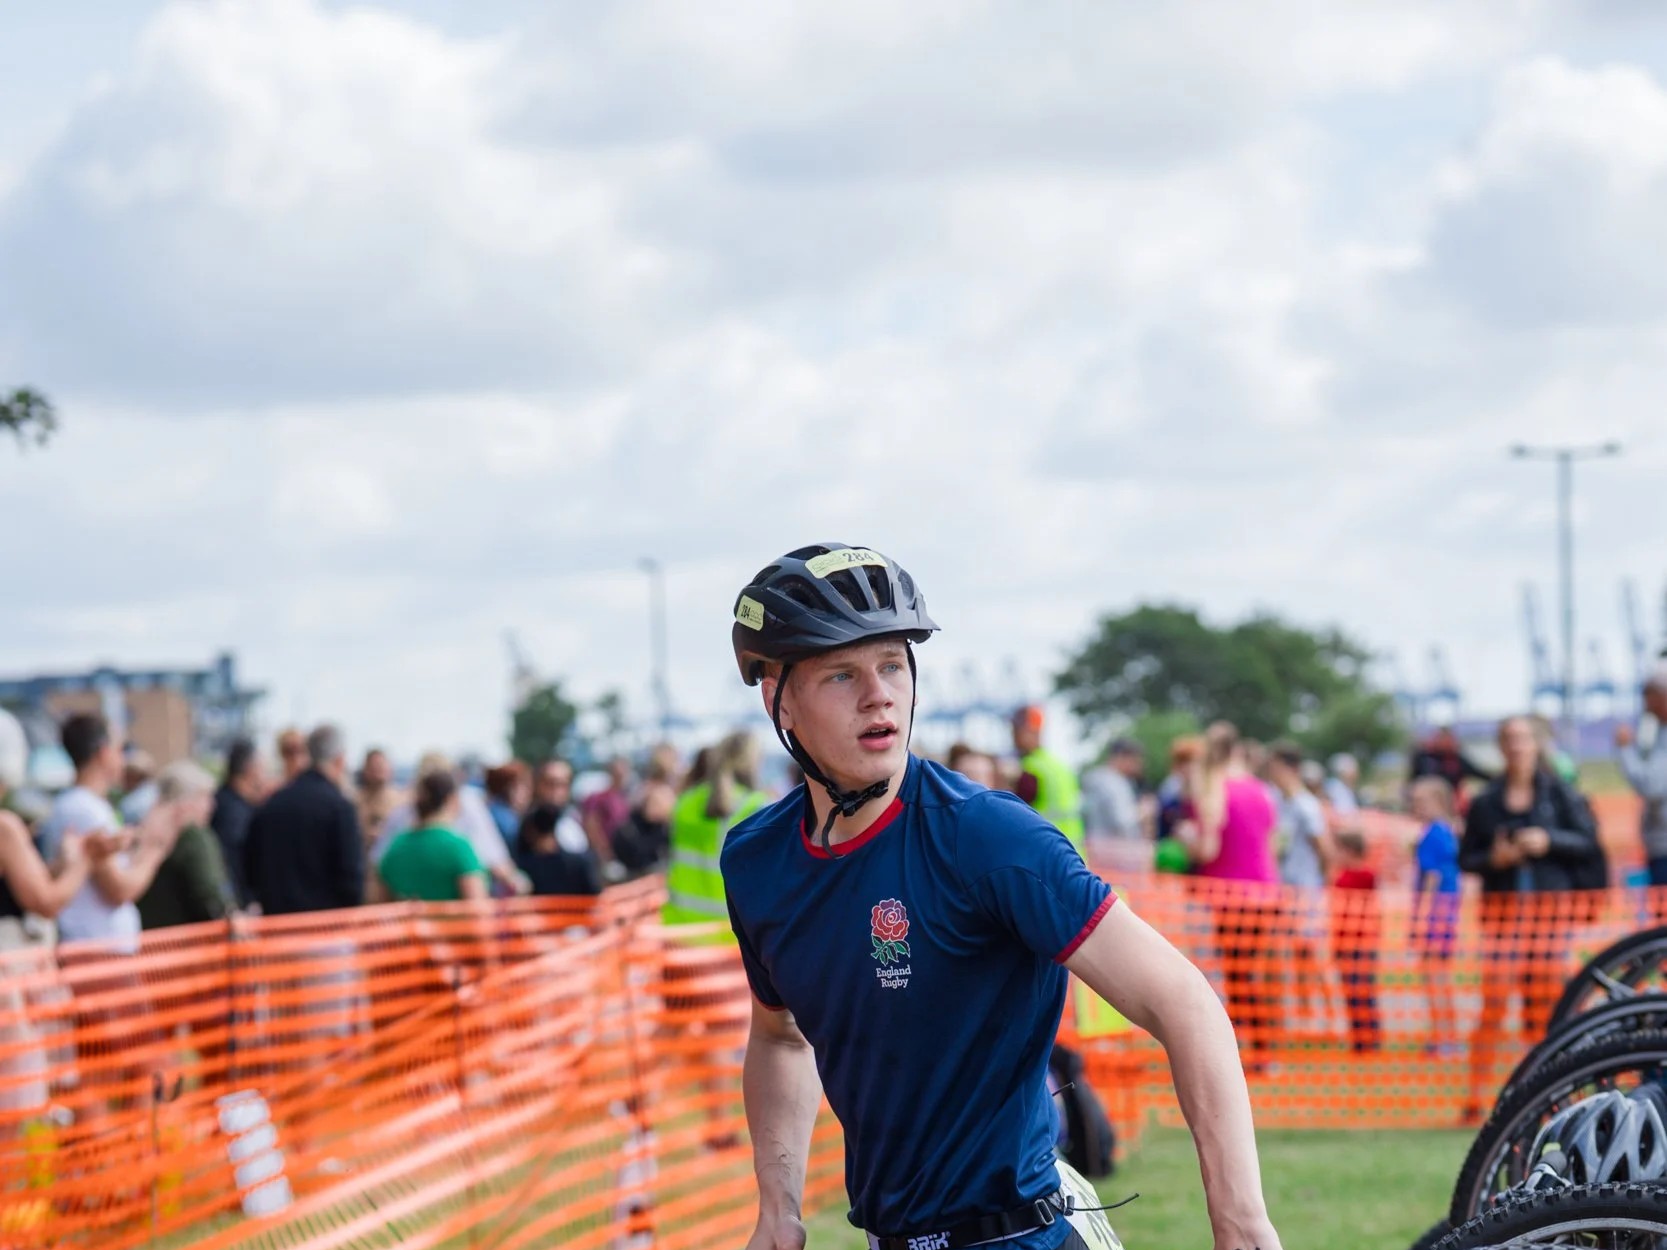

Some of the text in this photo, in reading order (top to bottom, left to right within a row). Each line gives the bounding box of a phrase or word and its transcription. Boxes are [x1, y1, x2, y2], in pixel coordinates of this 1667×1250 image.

[842, 552, 875, 563] 284
[876, 964, 912, 979] England
[881, 977, 909, 989] Rugby
